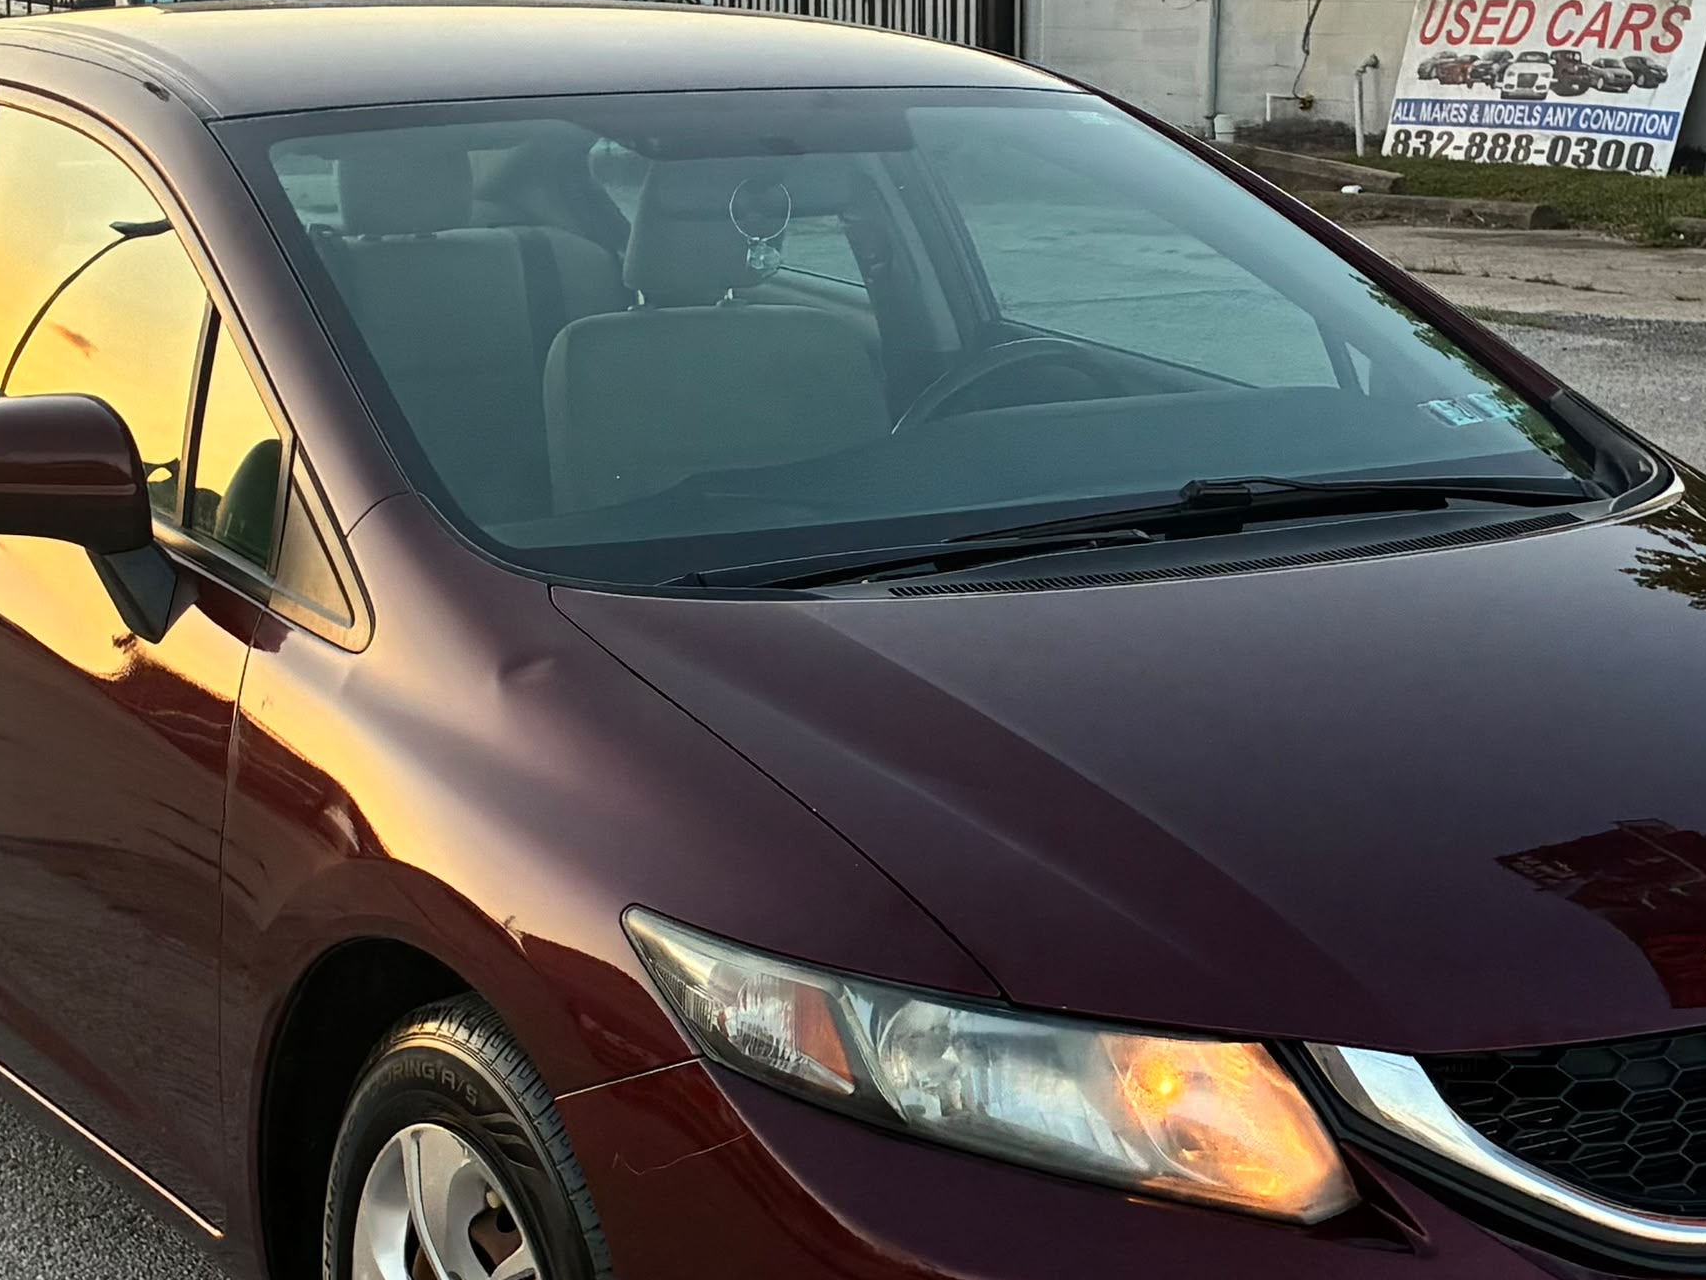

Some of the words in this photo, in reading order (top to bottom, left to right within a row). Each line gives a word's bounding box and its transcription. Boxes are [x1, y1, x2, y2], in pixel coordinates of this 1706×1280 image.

[1419, 0, 1538, 46] USED
[1546, 0, 1691, 54] CARS
[1393, 102, 1416, 121] ALL
[1419, 102, 1468, 123] MAKES
[1470, 104, 1480, 123] &
[1482, 104, 1542, 126] MODELS
[1542, 106, 1579, 128] ANY
[1579, 108, 1674, 136] CONDITION
[1391, 129, 1654, 172] 832-888-0300
